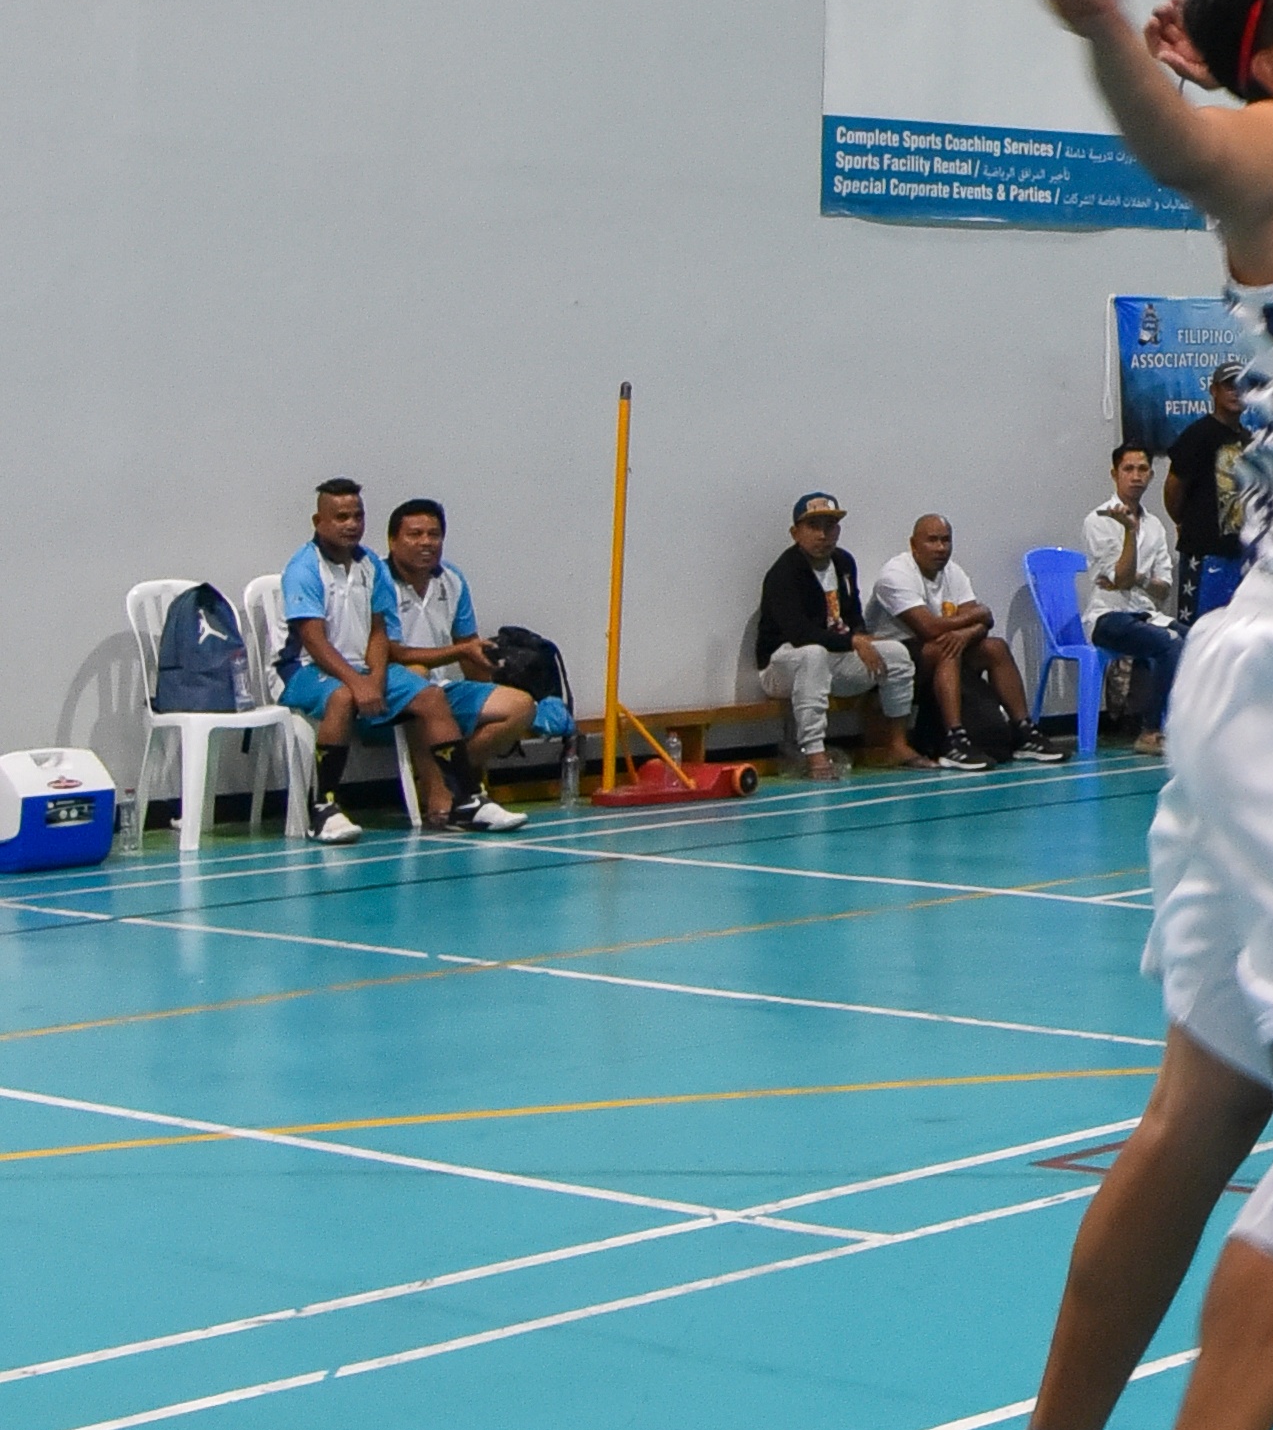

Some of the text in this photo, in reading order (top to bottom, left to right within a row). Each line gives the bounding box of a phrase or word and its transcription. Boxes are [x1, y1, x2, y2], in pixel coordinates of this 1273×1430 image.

[836, 126, 900, 148] Complete
[902, 130, 942, 151] Sports
[945, 133, 1001, 157] Coaching
[1004, 137, 1054, 157] Services
[835, 151, 880, 172] Sports
[883, 153, 931, 177] Facility
[933, 158, 972, 176] Rental
[834, 175, 886, 197] Special
[890, 178, 950, 201] Corporate
[952, 182, 993, 201] Events
[996, 183, 1006, 201] &
[1009, 185, 1052, 204] Parties
[1177, 329, 1234, 344] FILIPINO
[1131, 352, 1218, 370] ASSOCIATION
